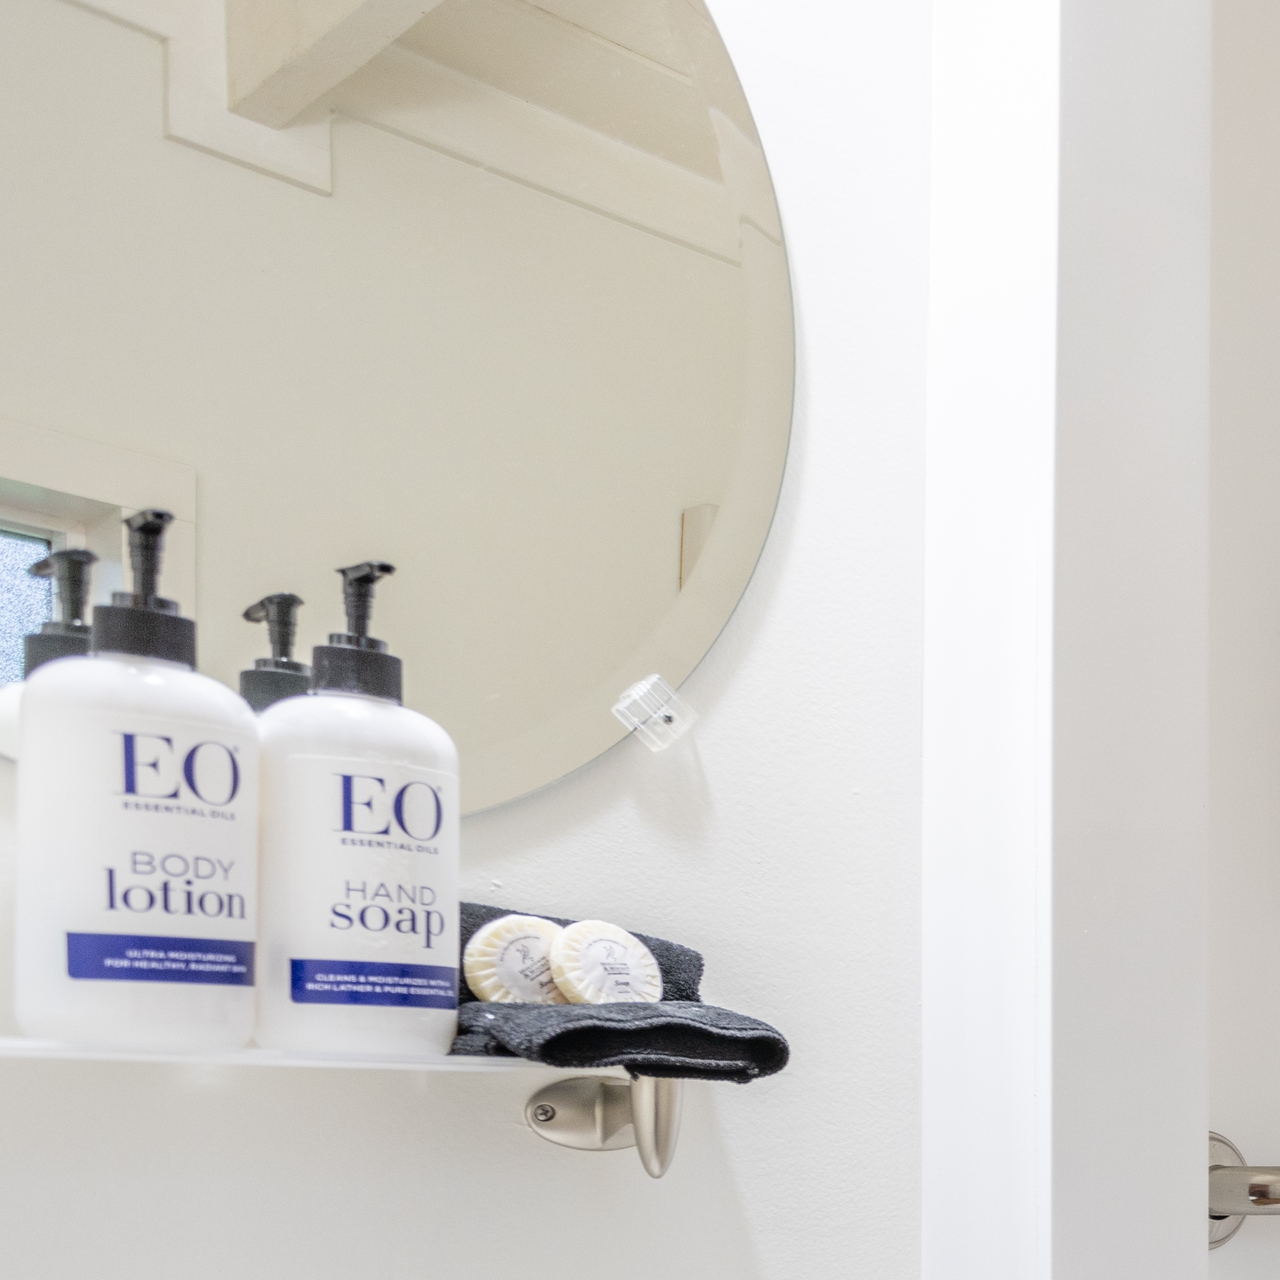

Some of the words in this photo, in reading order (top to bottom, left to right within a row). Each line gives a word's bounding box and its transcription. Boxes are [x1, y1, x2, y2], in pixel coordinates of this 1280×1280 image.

[112, 730, 241, 806] EO
[123, 801, 206, 818] ESSENTIAL
[209, 810, 236, 821] OILS
[332, 773, 443, 841] EO
[341, 837, 413, 852] ESSENTIAL
[415, 845, 440, 855] OILS
[131, 851, 235, 881] BODY
[105, 867, 247, 919] lotion
[345, 880, 437, 906] HAND
[329, 902, 445, 949] soap
